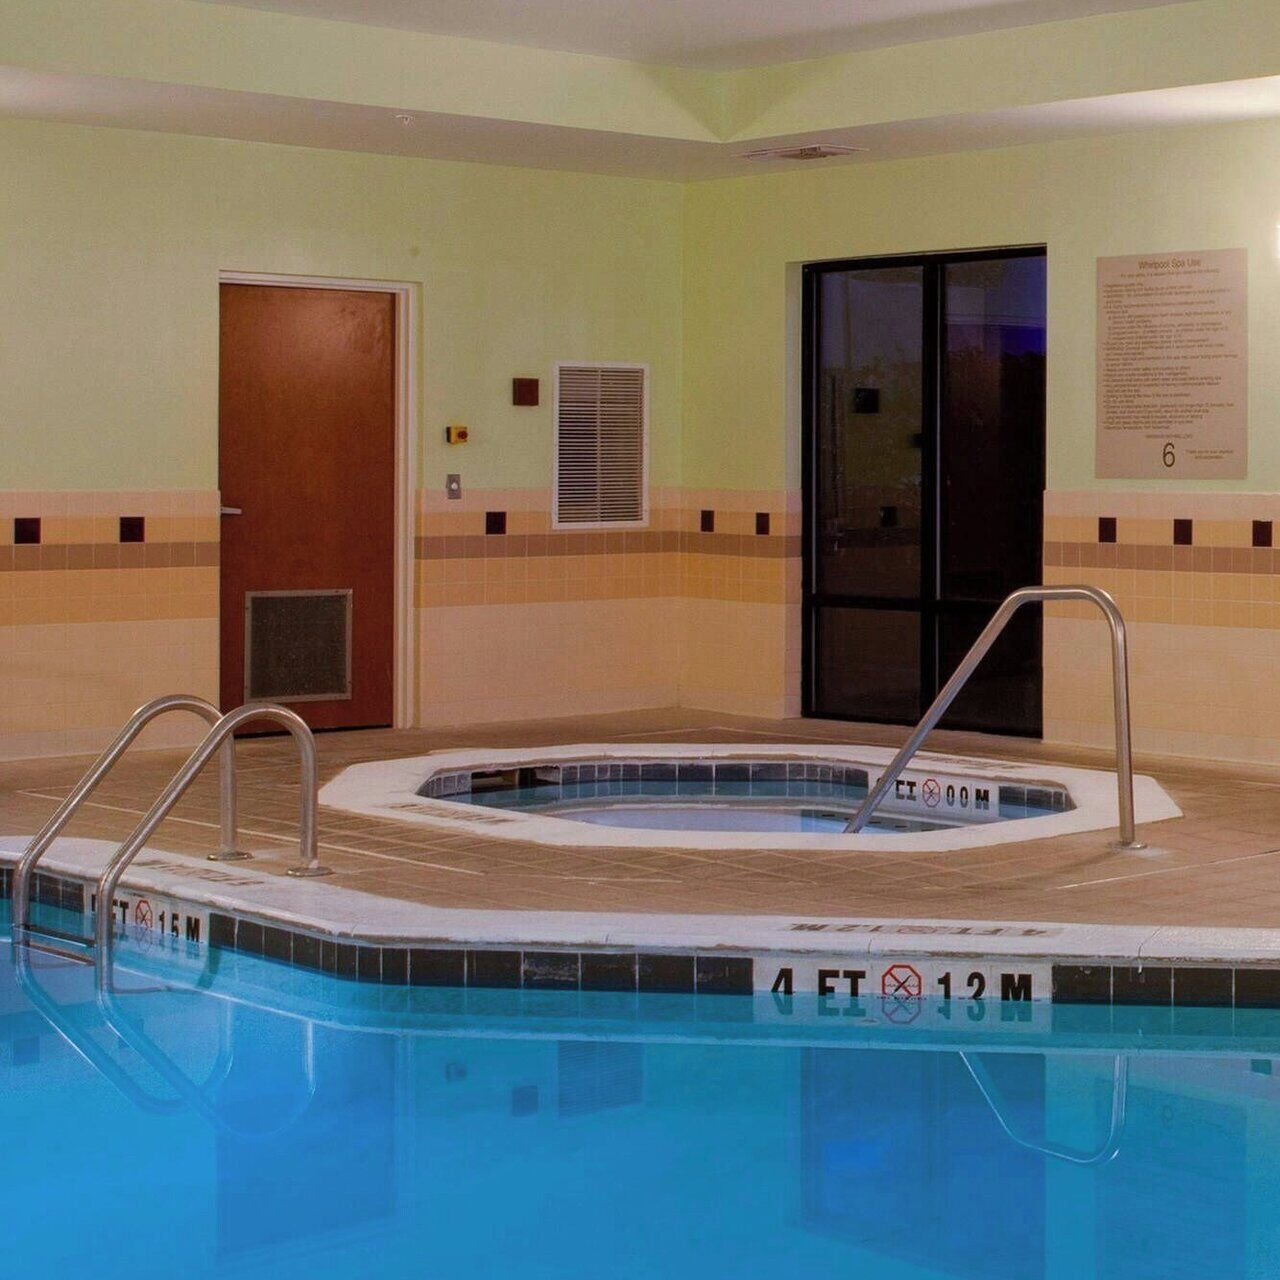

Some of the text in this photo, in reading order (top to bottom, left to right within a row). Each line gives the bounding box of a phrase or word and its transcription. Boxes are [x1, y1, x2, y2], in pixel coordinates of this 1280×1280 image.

[1162, 442, 1176, 468] 6
[771, 967, 793, 995] 4
[818, 968, 866, 998] FT
[1001, 973, 1033, 1002] M
